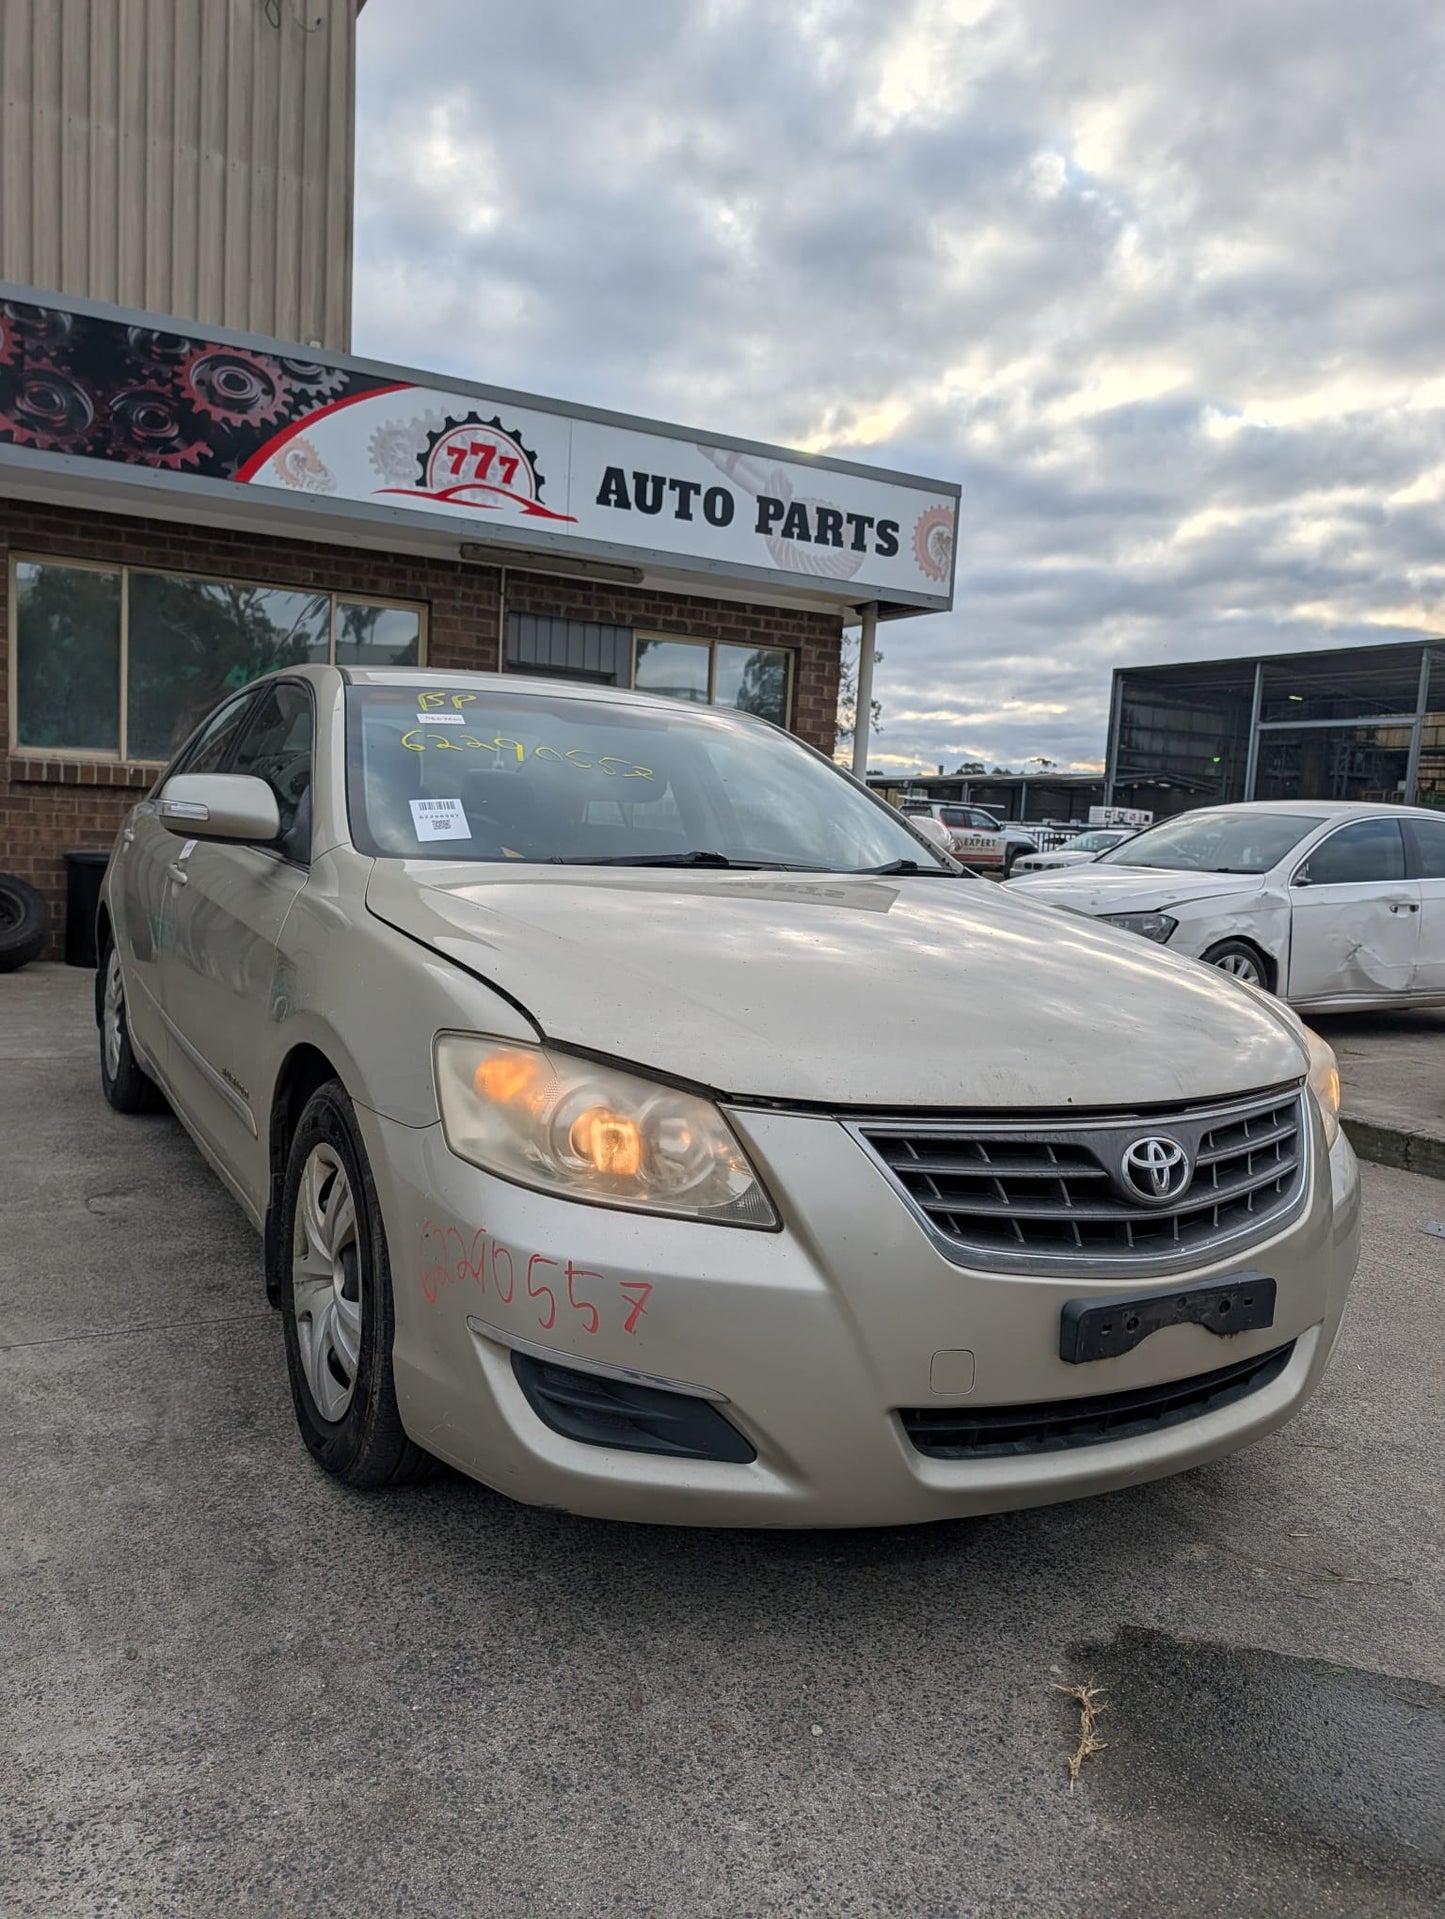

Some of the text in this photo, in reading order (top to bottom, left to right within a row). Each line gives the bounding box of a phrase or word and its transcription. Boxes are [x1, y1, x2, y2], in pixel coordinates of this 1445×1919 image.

[446, 443, 518, 485] 777
[596, 466, 901, 558] AUTO PARTS
[417, 692, 477, 711] BP
[963, 837, 996, 847] EXPERT
